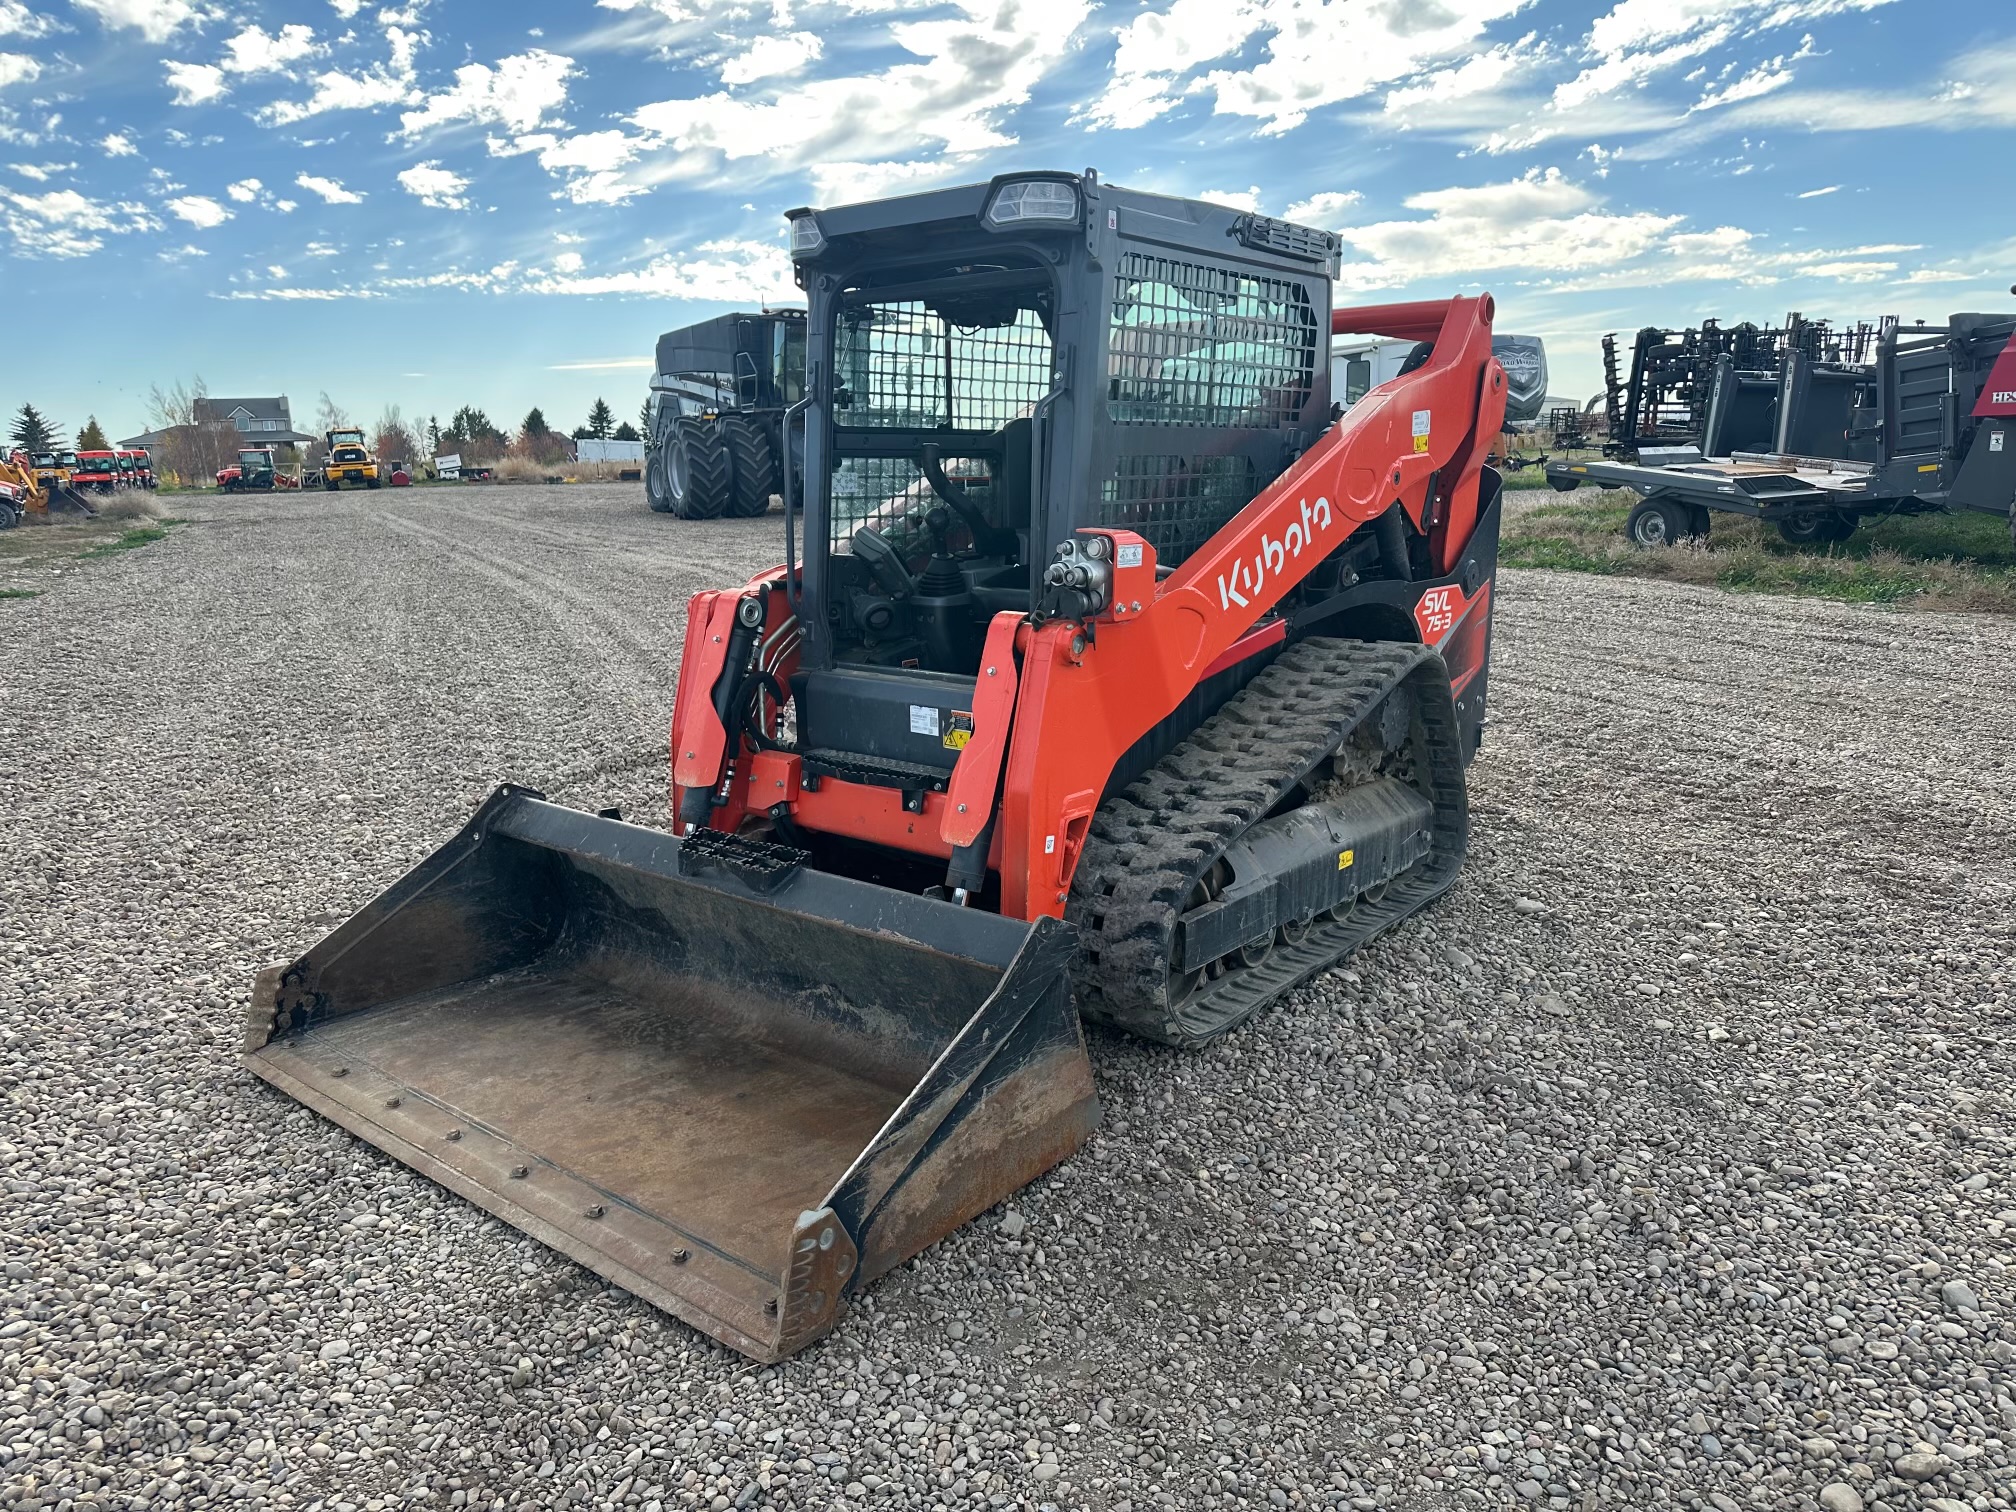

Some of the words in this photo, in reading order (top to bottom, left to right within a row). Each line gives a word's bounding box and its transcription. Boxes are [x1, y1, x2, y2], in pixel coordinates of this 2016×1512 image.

[1217, 496, 1332, 612] Kubota
[1422, 590, 1452, 615] SVL
[1426, 612, 1452, 633] 75-3
